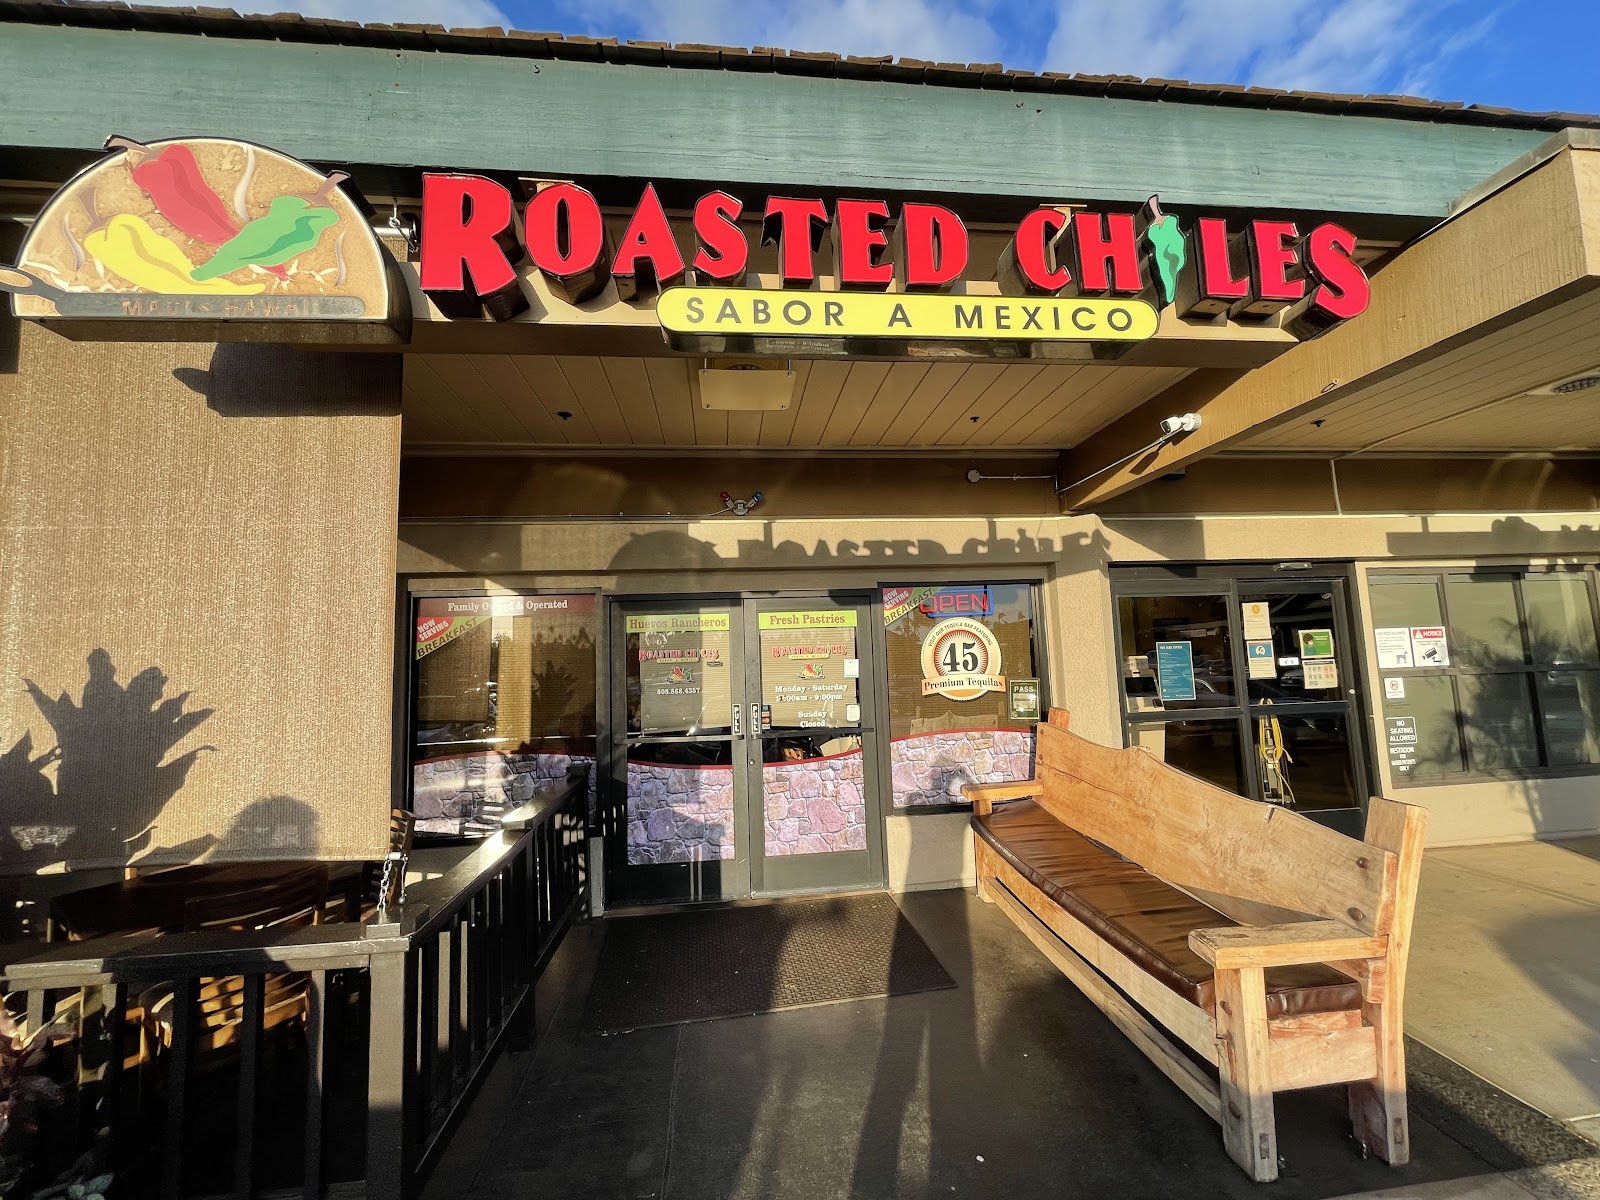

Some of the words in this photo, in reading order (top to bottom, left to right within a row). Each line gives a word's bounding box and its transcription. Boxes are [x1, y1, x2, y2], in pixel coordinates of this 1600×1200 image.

[420, 172, 968, 297] ROASTED
[1016, 193, 1371, 320] CHILES
[686, 296, 845, 327] SABOR
[888, 303, 913, 328] A
[955, 304, 1134, 333] MEXICO
[883, 589, 898, 602] NOW
[884, 590, 910, 610] SERVING
[447, 602, 480, 613] Family
[526, 600, 568, 612] Operated
[884, 588, 934, 624] BREAKFAST
[919, 593, 989, 613] OPEN
[417, 619, 436, 632] NOW
[629, 619, 668, 629] Huevos
[671, 617, 727, 628] Rancheros
[769, 614, 799, 625] Fresh
[802, 613, 846, 624] Pastries
[419, 620, 450, 641] SERVING
[944, 622, 963, 631] TEQUILA
[417, 617, 478, 658] BREAKFAST
[639, 649, 682, 661] ROASTED
[771, 645, 813, 657] ROASTED
[943, 642, 979, 673] 45
[774, 685, 806, 693] Monday
[812, 684, 848, 692] Saturday
[924, 679, 964, 691] Premium
[966, 677, 1003, 688] Tequilas
[1014, 685, 1035, 693] PASS
[799, 720, 826, 728] Closed
[1389, 734, 1416, 742] ALLOWED
